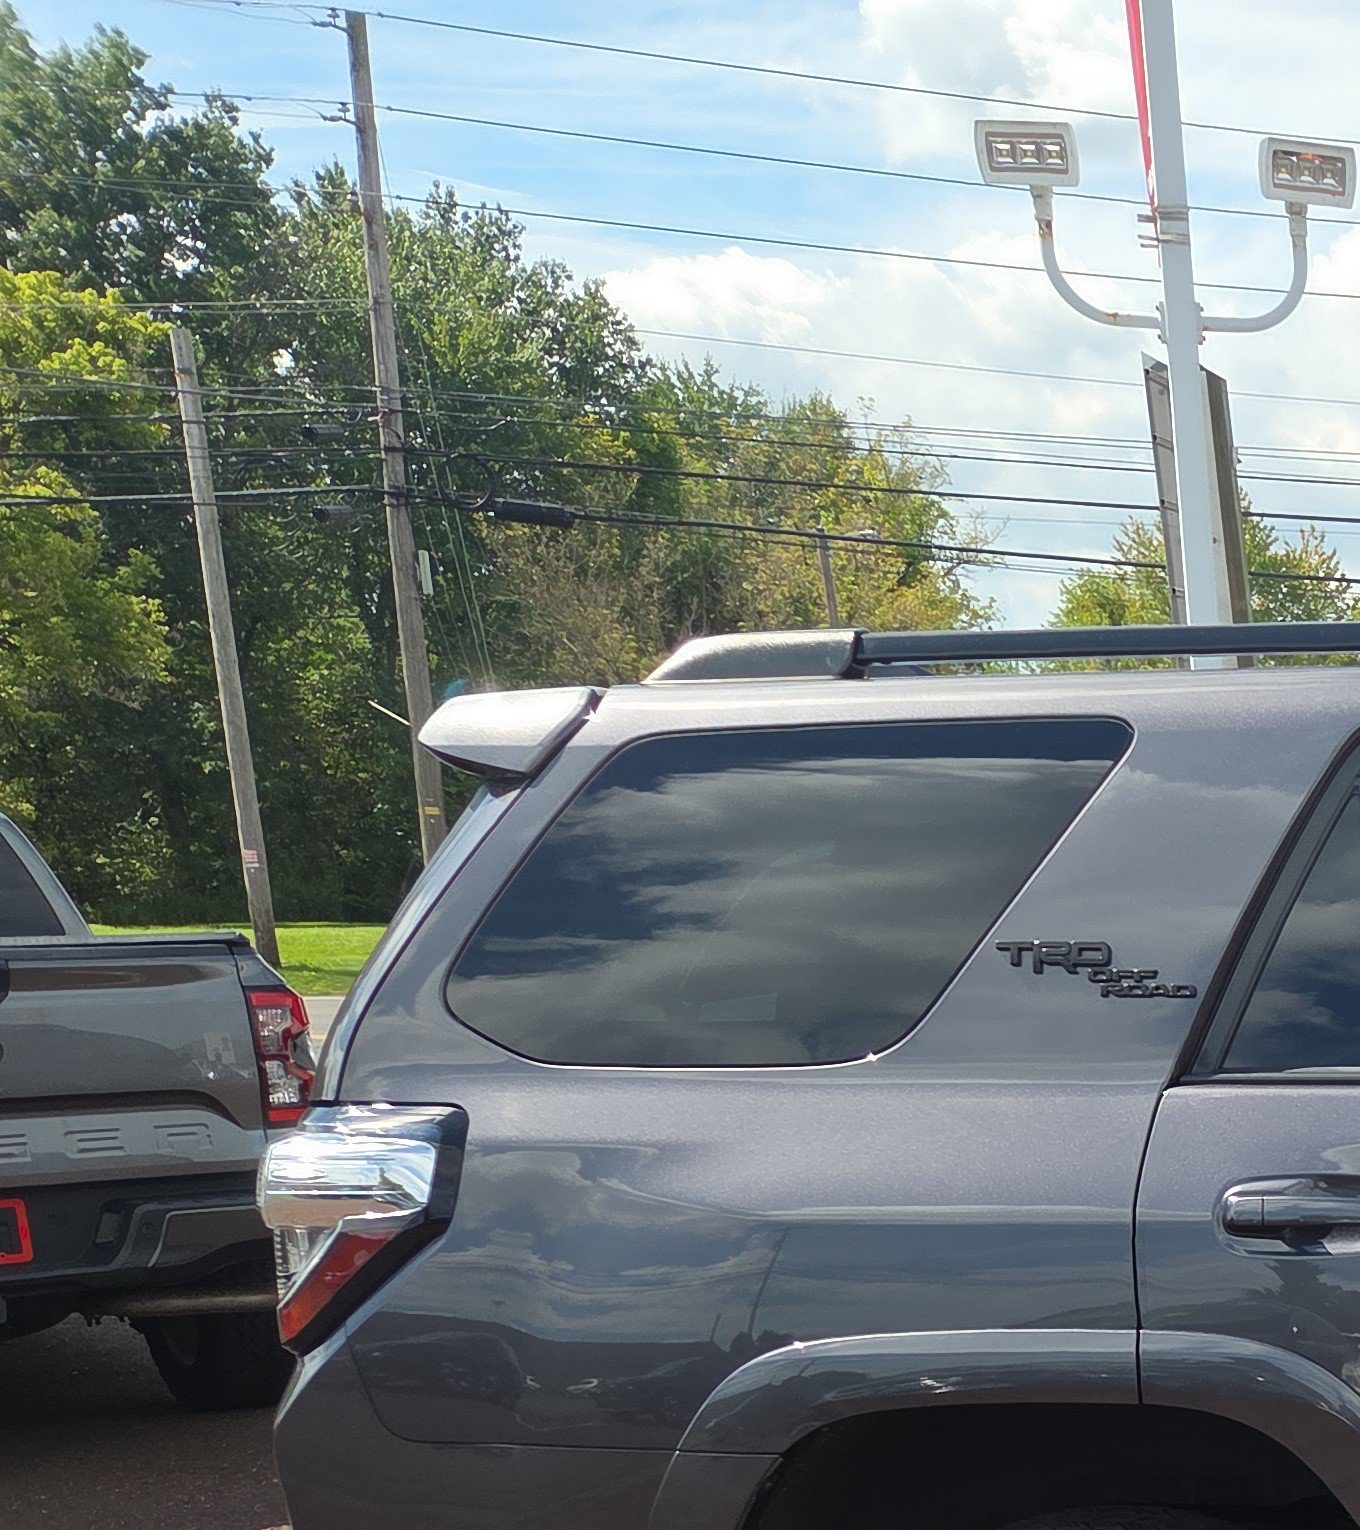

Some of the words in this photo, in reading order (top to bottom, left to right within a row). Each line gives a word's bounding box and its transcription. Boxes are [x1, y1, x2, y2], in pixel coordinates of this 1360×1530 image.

[995, 940, 1112, 975] TRD
[1088, 967, 1159, 983] OFF
[1100, 982, 1198, 998] ROAD
